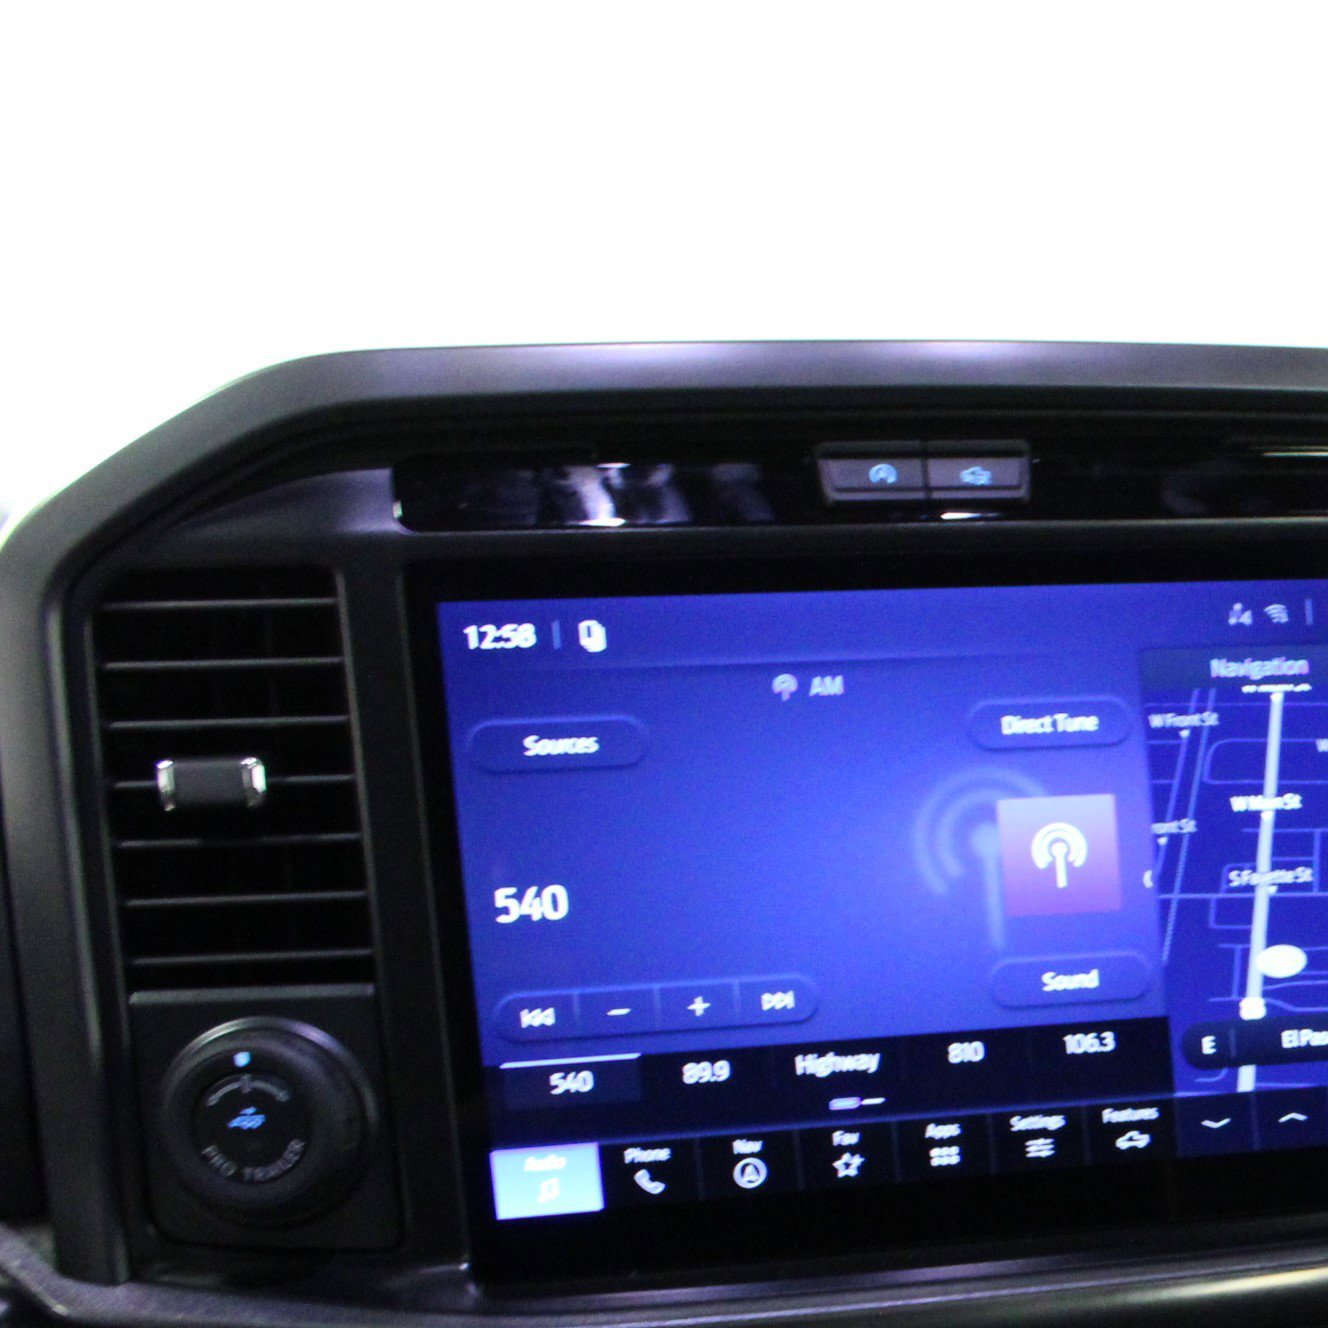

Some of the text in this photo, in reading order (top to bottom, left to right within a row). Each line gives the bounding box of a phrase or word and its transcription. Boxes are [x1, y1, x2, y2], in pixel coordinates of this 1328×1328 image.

[464, 623, 537, 650] 12:58
[1210, 657, 1310, 680] Navigation
[809, 674, 845, 696] AM
[1001, 713, 1099, 735] Direct Tune
[523, 734, 599, 756] Sources
[494, 884, 569, 923] 540
[1041, 968, 1100, 992] Sound
[948, 1041, 985, 1064] 810
[1063, 1031, 1116, 1054] 106.3
[1201, 1035, 1217, 1054] E
[682, 1060, 731, 1084] 89.9
[795, 1051, 881, 1078] Highway
[549, 1070, 594, 1094] 540
[1102, 1107, 1160, 1124] Features
[623, 1147, 672, 1164] Phone
